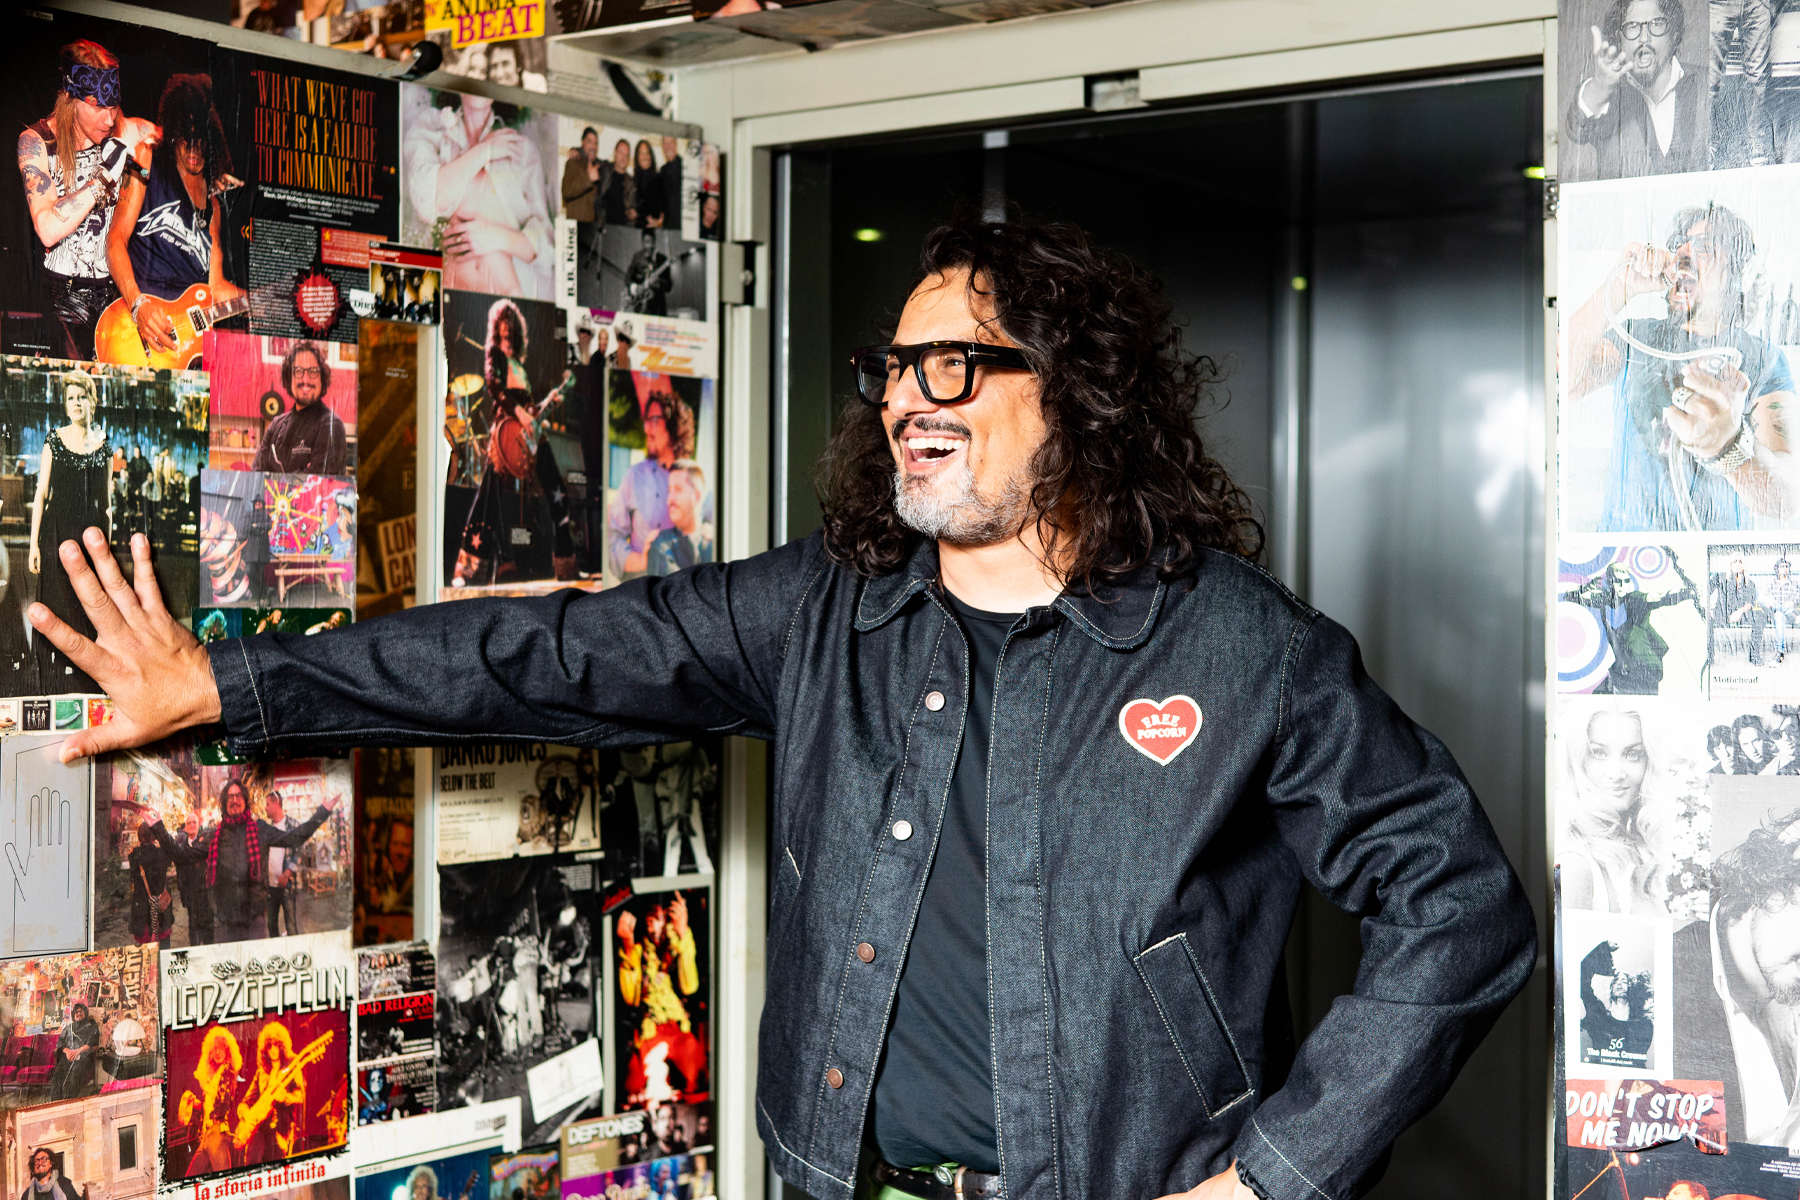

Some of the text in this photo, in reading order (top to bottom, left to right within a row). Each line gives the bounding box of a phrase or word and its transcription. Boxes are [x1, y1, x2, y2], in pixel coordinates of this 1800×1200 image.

[456, 3, 539, 44] BEAT
[352, 88, 376, 126] GOT
[255, 107, 378, 163] HERE IS A FAILURE
[255, 144, 273, 183] TO
[567, 226, 577, 263] King
[1137, 726, 1187, 740] POPCORN
[1140, 713, 1181, 729] FREE
[464, 772, 478, 791] THE
[479, 772, 496, 789] BELT
[358, 993, 434, 1016] BAD RELIGION
[1587, 1047, 1648, 1061] The Black Crowes
[1609, 1037, 1625, 1050] 56
[1566, 1088, 1715, 1120] DON'T STOP
[568, 1114, 645, 1146] DEFTONES
[1581, 1120, 1621, 1147] ME
[194, 1163, 326, 1200] la storia infinita
